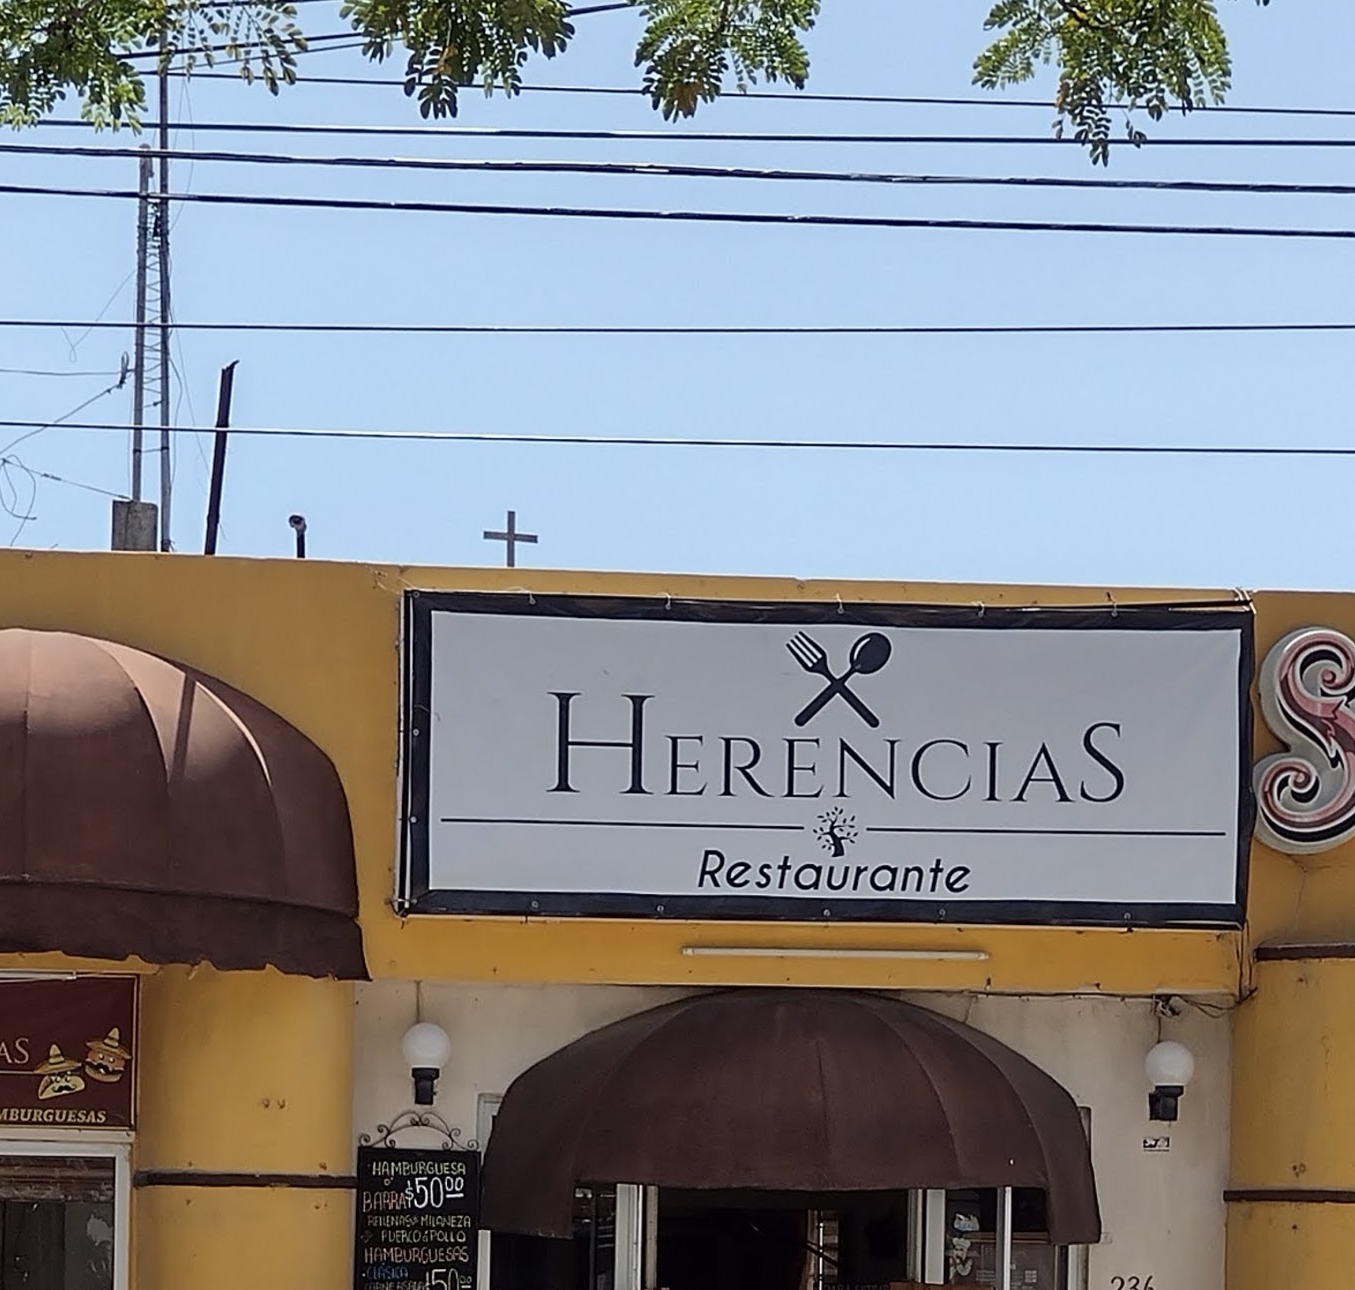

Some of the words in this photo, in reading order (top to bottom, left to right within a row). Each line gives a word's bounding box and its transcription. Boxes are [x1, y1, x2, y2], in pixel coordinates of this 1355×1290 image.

[546, 690, 1125, 805] HERENCIAS
[697, 848, 970, 896] Restaurante
[372, 1161, 466, 1177] HAMBURGUESA
[430, 1230, 466, 1242] POLLO
[364, 1246, 469, 1264] HAMBURGUESAS
